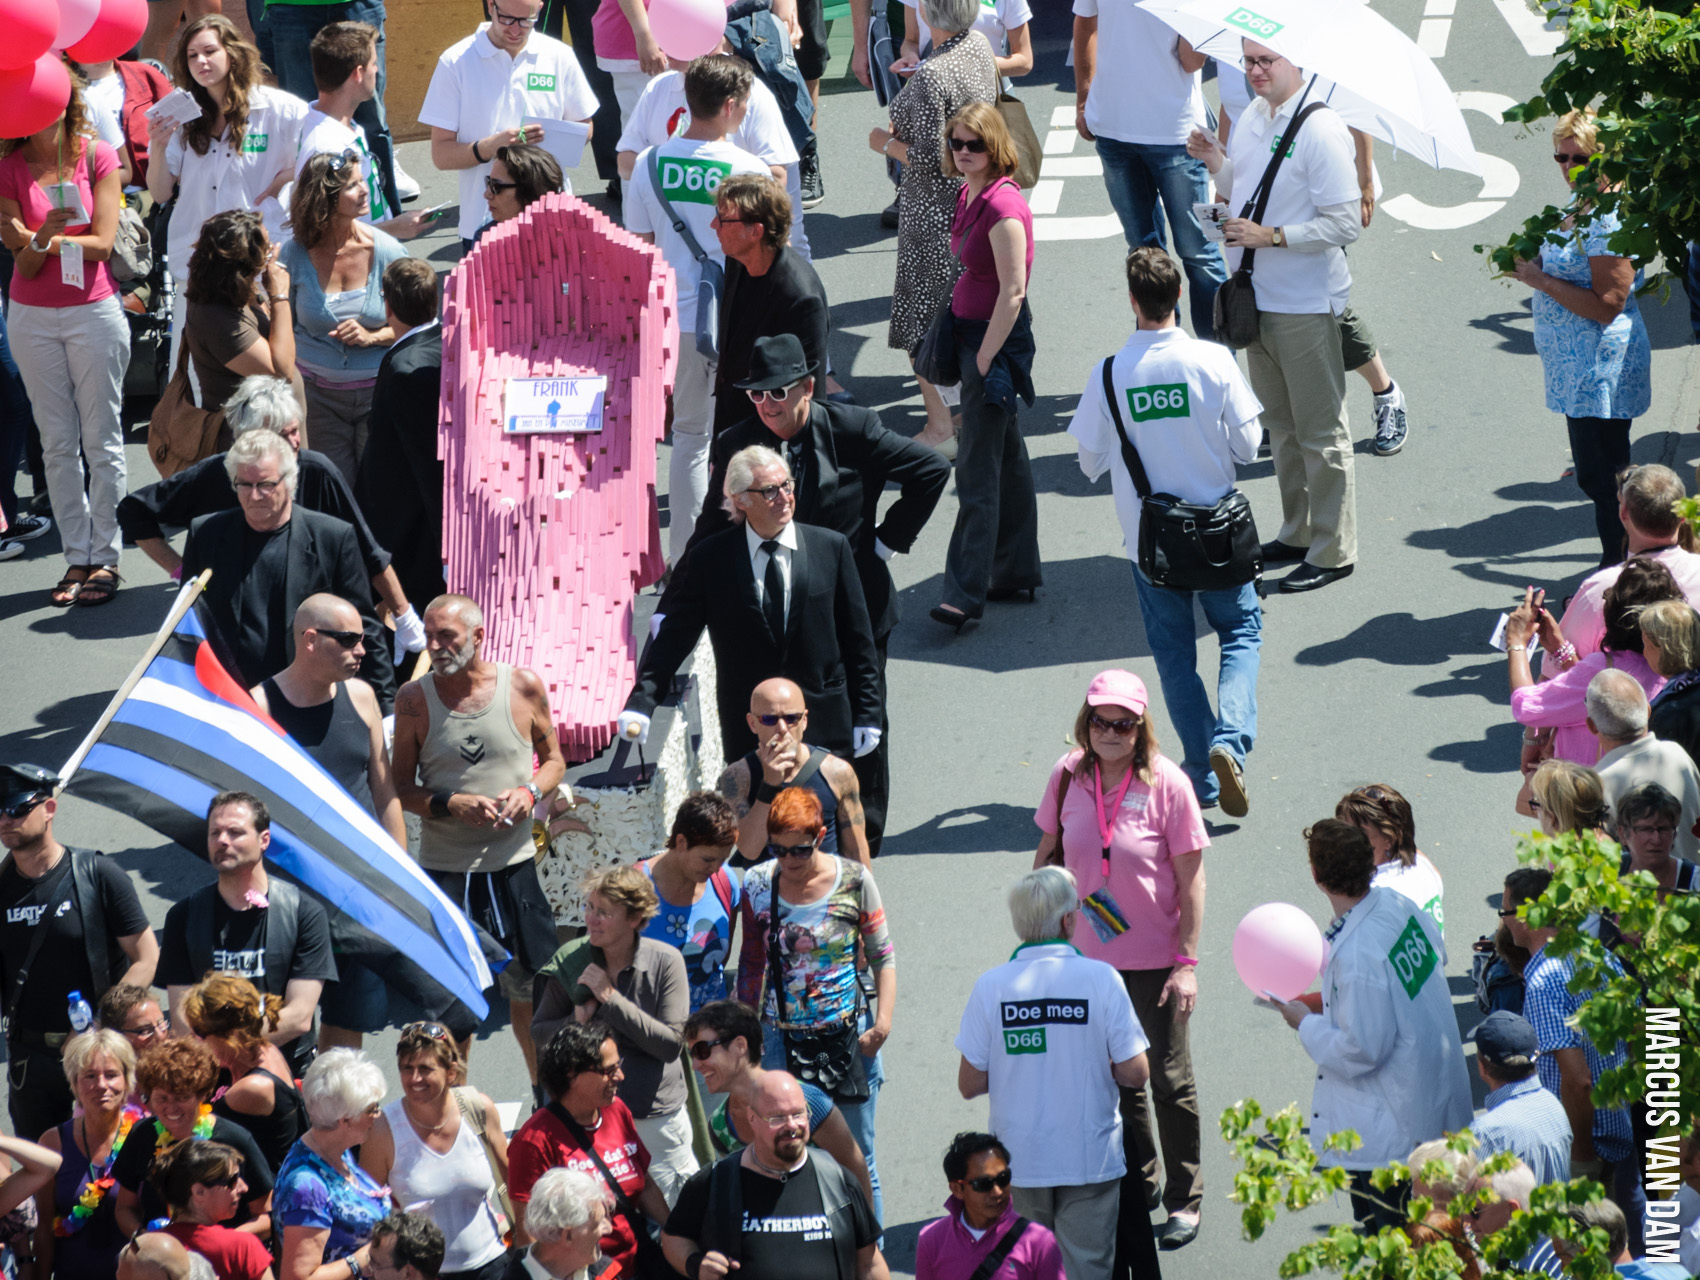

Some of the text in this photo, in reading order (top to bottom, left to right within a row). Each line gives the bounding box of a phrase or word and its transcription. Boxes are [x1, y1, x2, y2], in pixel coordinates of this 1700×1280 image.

[1231, 10, 1278, 35] D66
[529, 75, 554, 88] D66
[662, 162, 723, 193] D66
[533, 380, 579, 397] FRANK
[1132, 388, 1184, 414] D66
[1394, 929, 1428, 984] D66
[1004, 1004, 1085, 1021] Doe mee
[1007, 1032, 1042, 1048] D66
